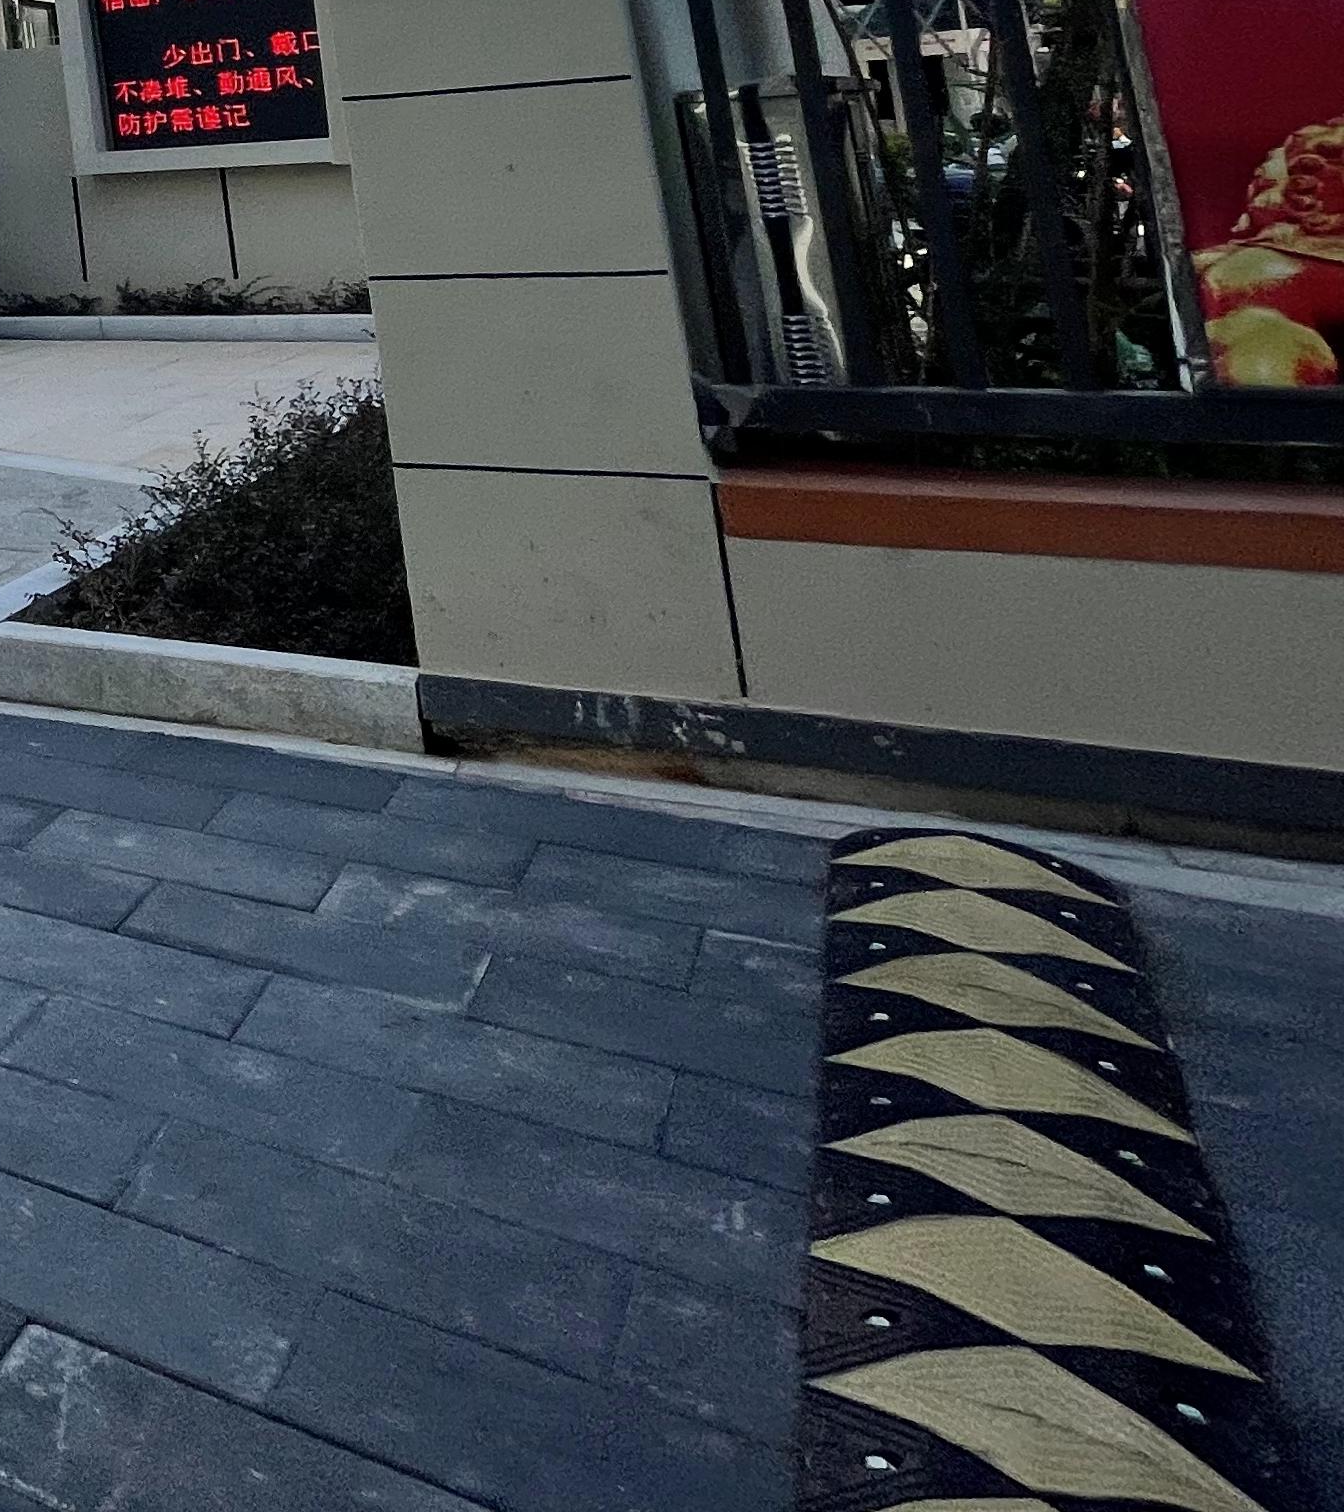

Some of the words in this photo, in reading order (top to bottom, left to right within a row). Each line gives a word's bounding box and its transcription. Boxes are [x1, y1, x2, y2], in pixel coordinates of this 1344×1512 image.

[118, 104, 251, 136] 防护需谨记
